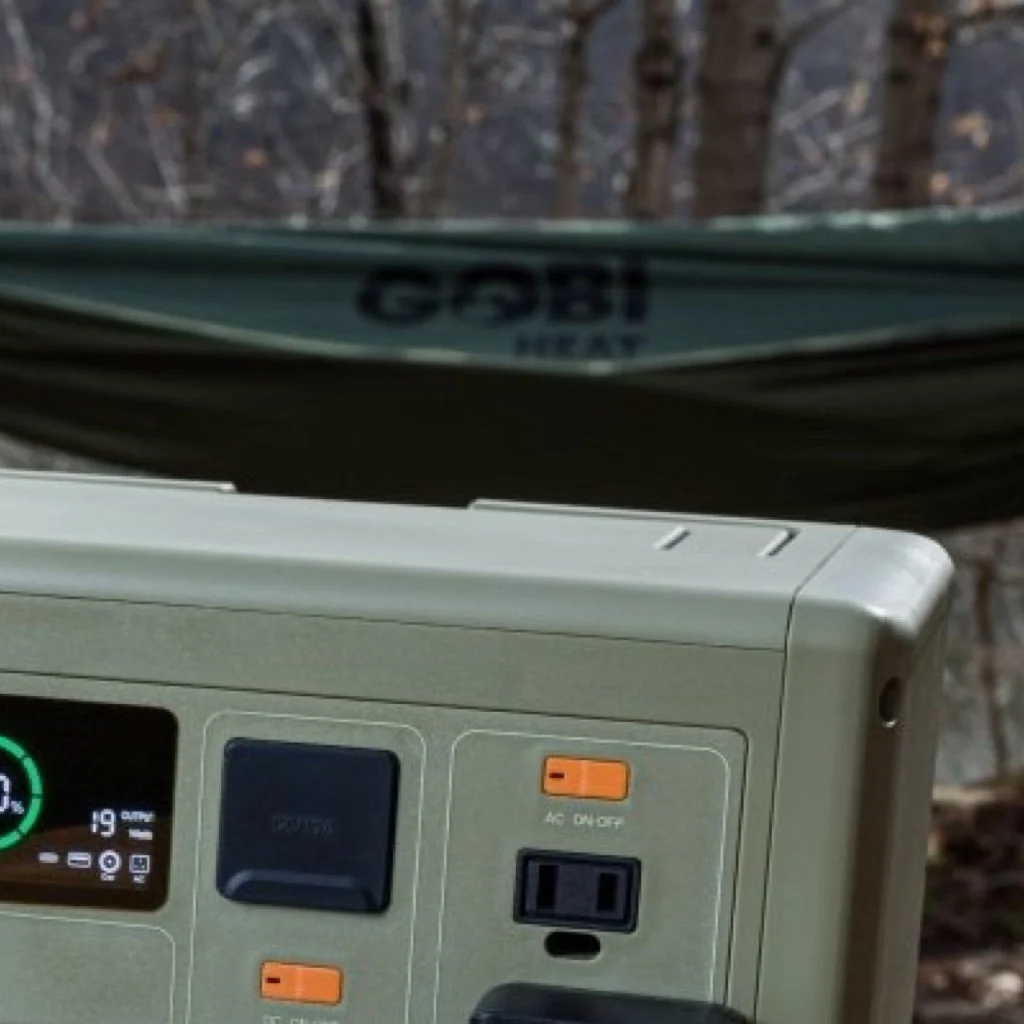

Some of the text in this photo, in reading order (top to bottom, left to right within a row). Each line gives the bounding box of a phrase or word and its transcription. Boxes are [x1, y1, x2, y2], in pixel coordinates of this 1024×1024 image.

[355, 256, 650, 329] GOBI
[90, 808, 117, 838] 19
[544, 810, 566, 826] AC
